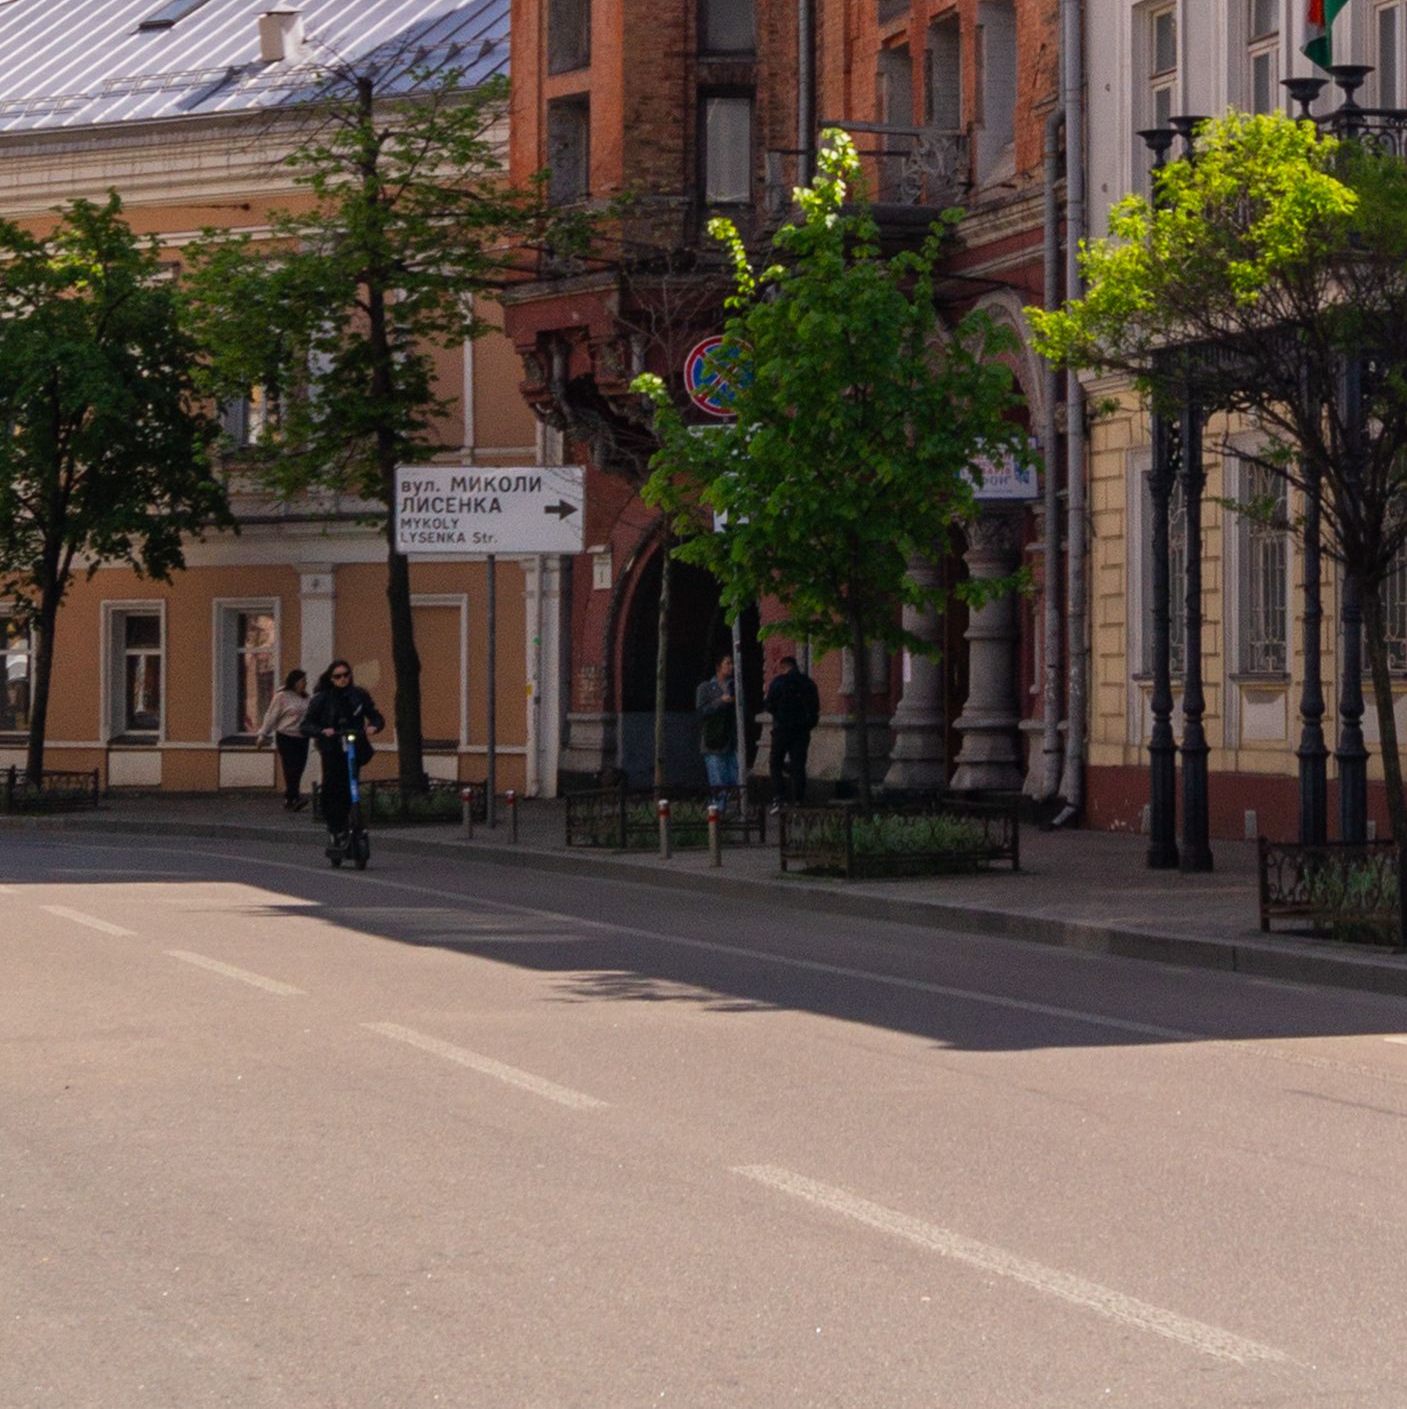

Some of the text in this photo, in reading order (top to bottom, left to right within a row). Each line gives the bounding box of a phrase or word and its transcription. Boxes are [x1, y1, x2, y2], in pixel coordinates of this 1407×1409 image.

[401, 476, 541, 497] вул. МИКОЛИ
[401, 497, 502, 513] ЛИСЕНКА
[401, 518, 459, 529] MYKOLY
[401, 532, 498, 544] LYSENKA Str.
